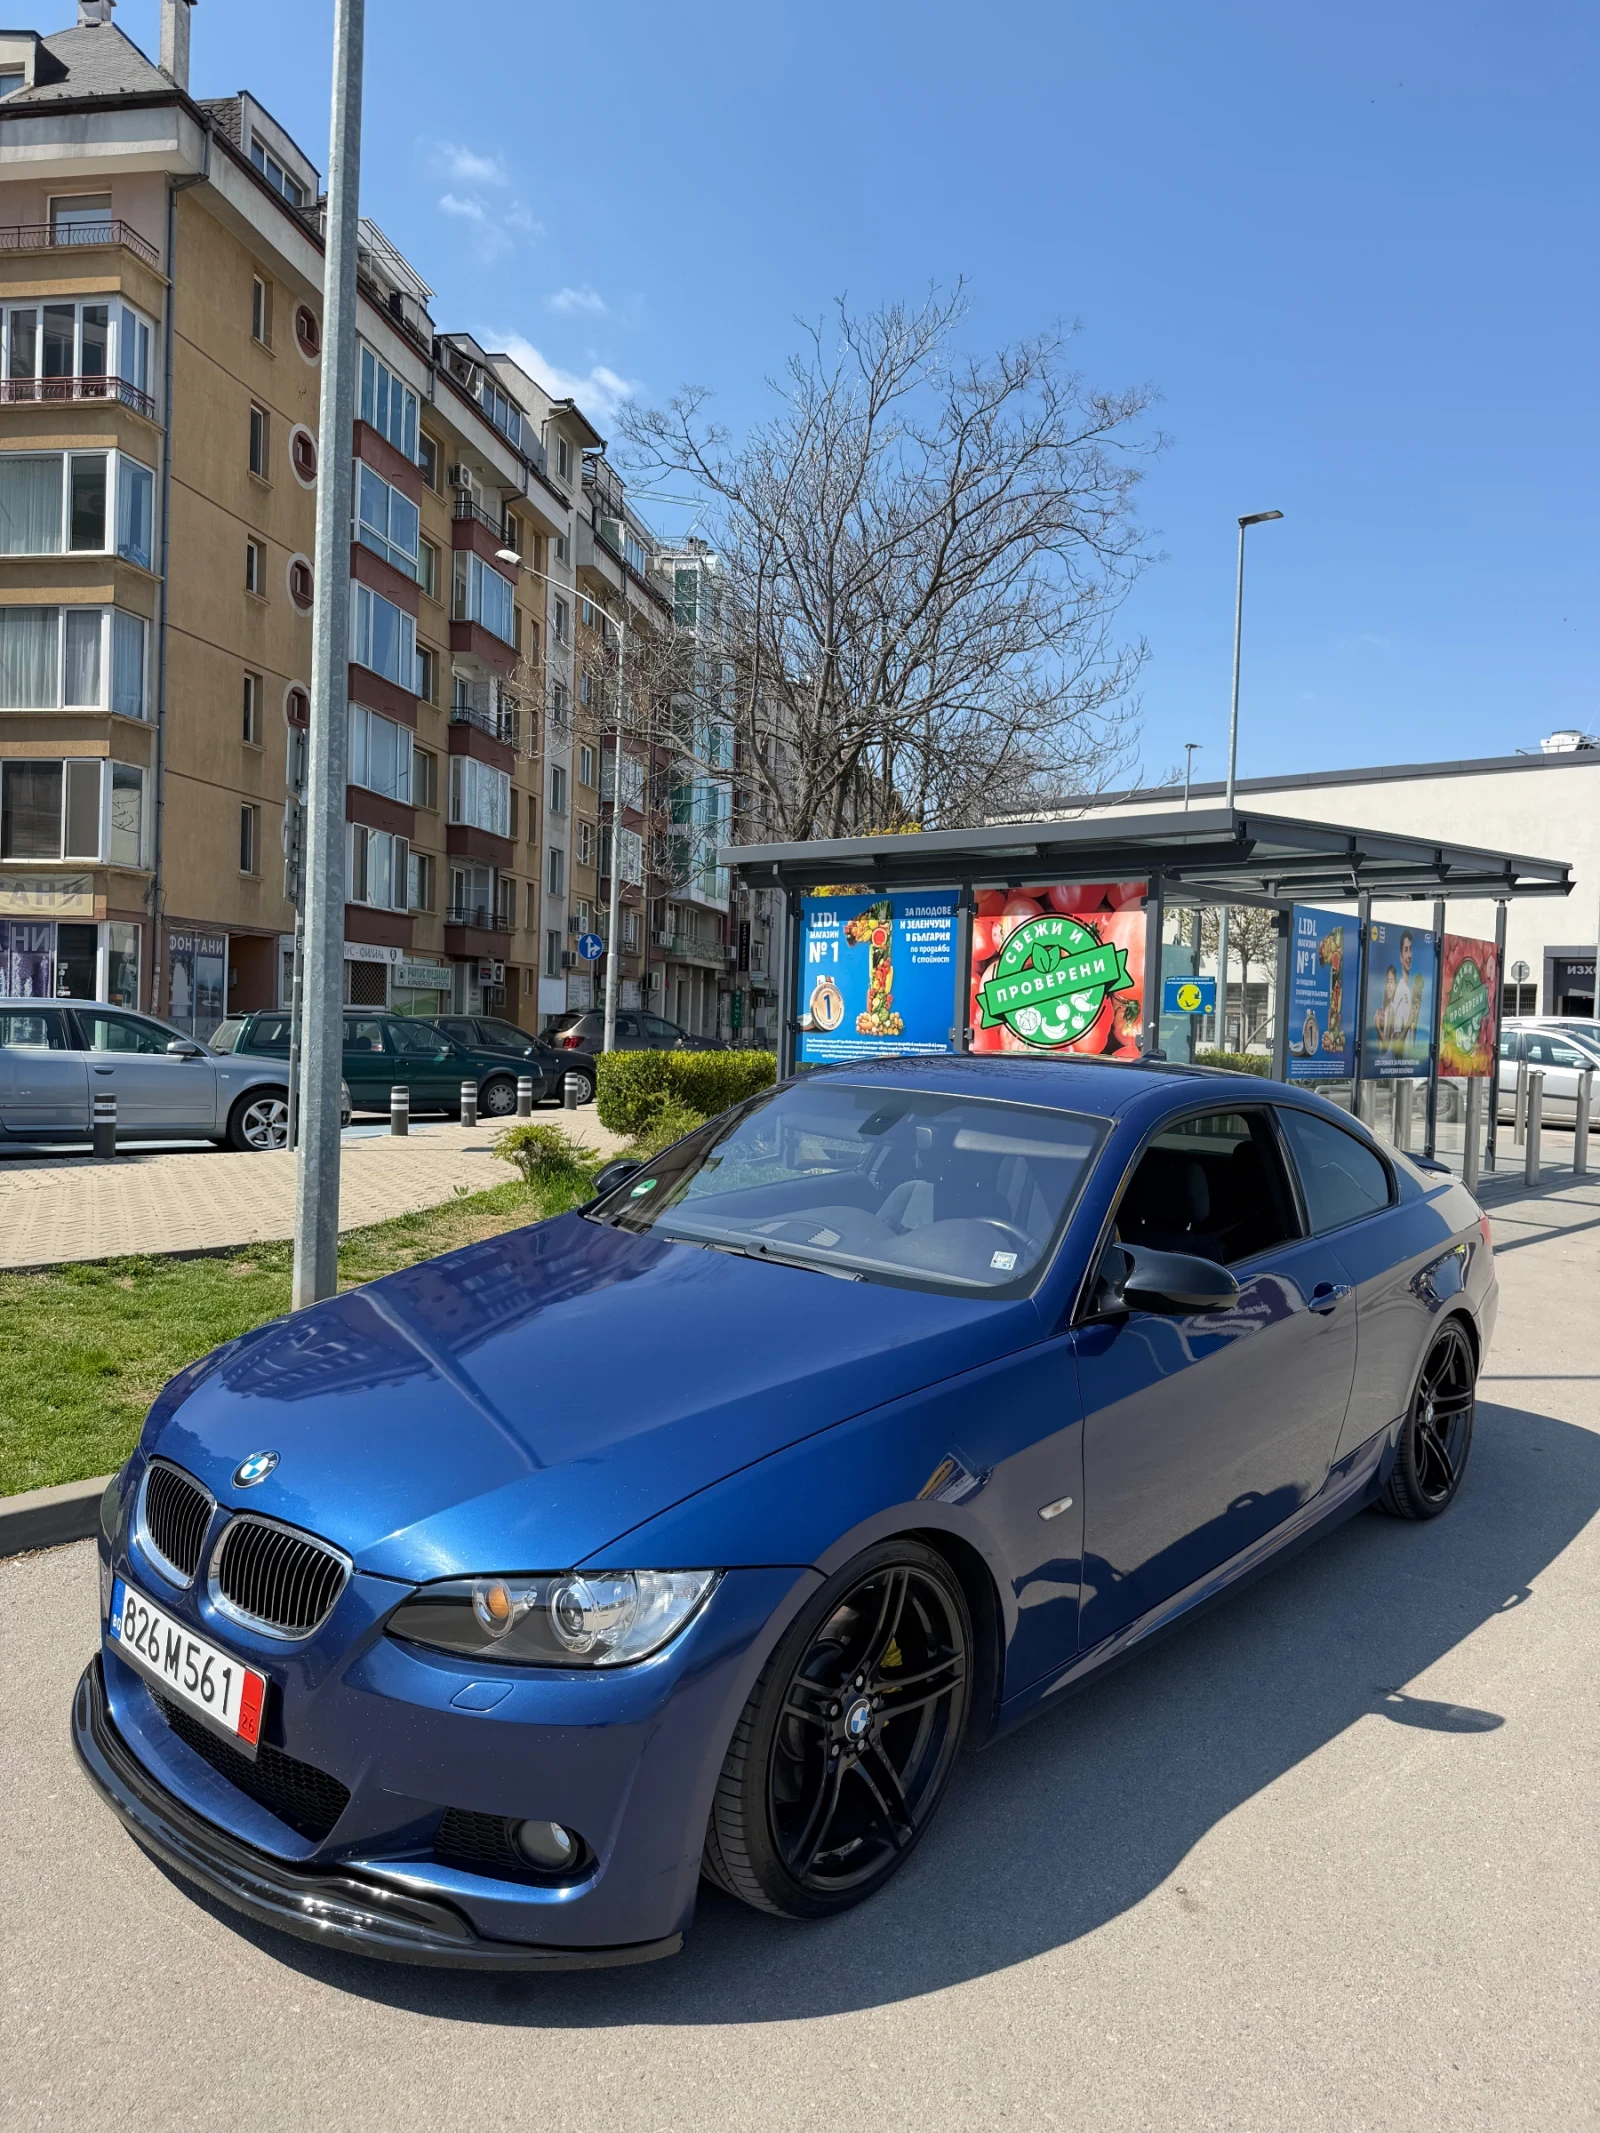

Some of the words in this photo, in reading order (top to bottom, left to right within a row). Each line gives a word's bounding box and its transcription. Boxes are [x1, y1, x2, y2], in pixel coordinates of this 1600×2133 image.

[0, 882, 83, 906] АНИ
[810, 912, 840, 928] LIDL
[904, 907, 914, 917] ЗА
[915, 906, 952, 917] ПЛОДОВЕ
[810, 930, 840, 939] МАГАЗИН
[900, 920, 906, 929] И
[907, 918, 951, 930] ЗЕЛЕНЧУЦИ
[1298, 917, 1317, 937] LIDL
[0, 926, 50, 952] НИ
[169, 934, 223, 954] ФОНТАНИ
[905, 932, 911, 942] В
[911, 931, 951, 942] БЪЛГАРИЯ
[1005, 921, 1063, 964] СВЕЖИ
[1069, 928, 1083, 945] И
[830, 941, 839, 963] 1
[1311, 952, 1316, 975] 1
[996, 959, 1106, 1003] ПРОВЕРЕНИ
[1453, 964, 1473, 993] СВЕЖИ
[823, 993, 832, 1020] 1
[1449, 993, 1484, 1023] ПРОВЕРЕНИ
[112, 1613, 122, 1631] BG
[241, 1713, 255, 1734] 26
